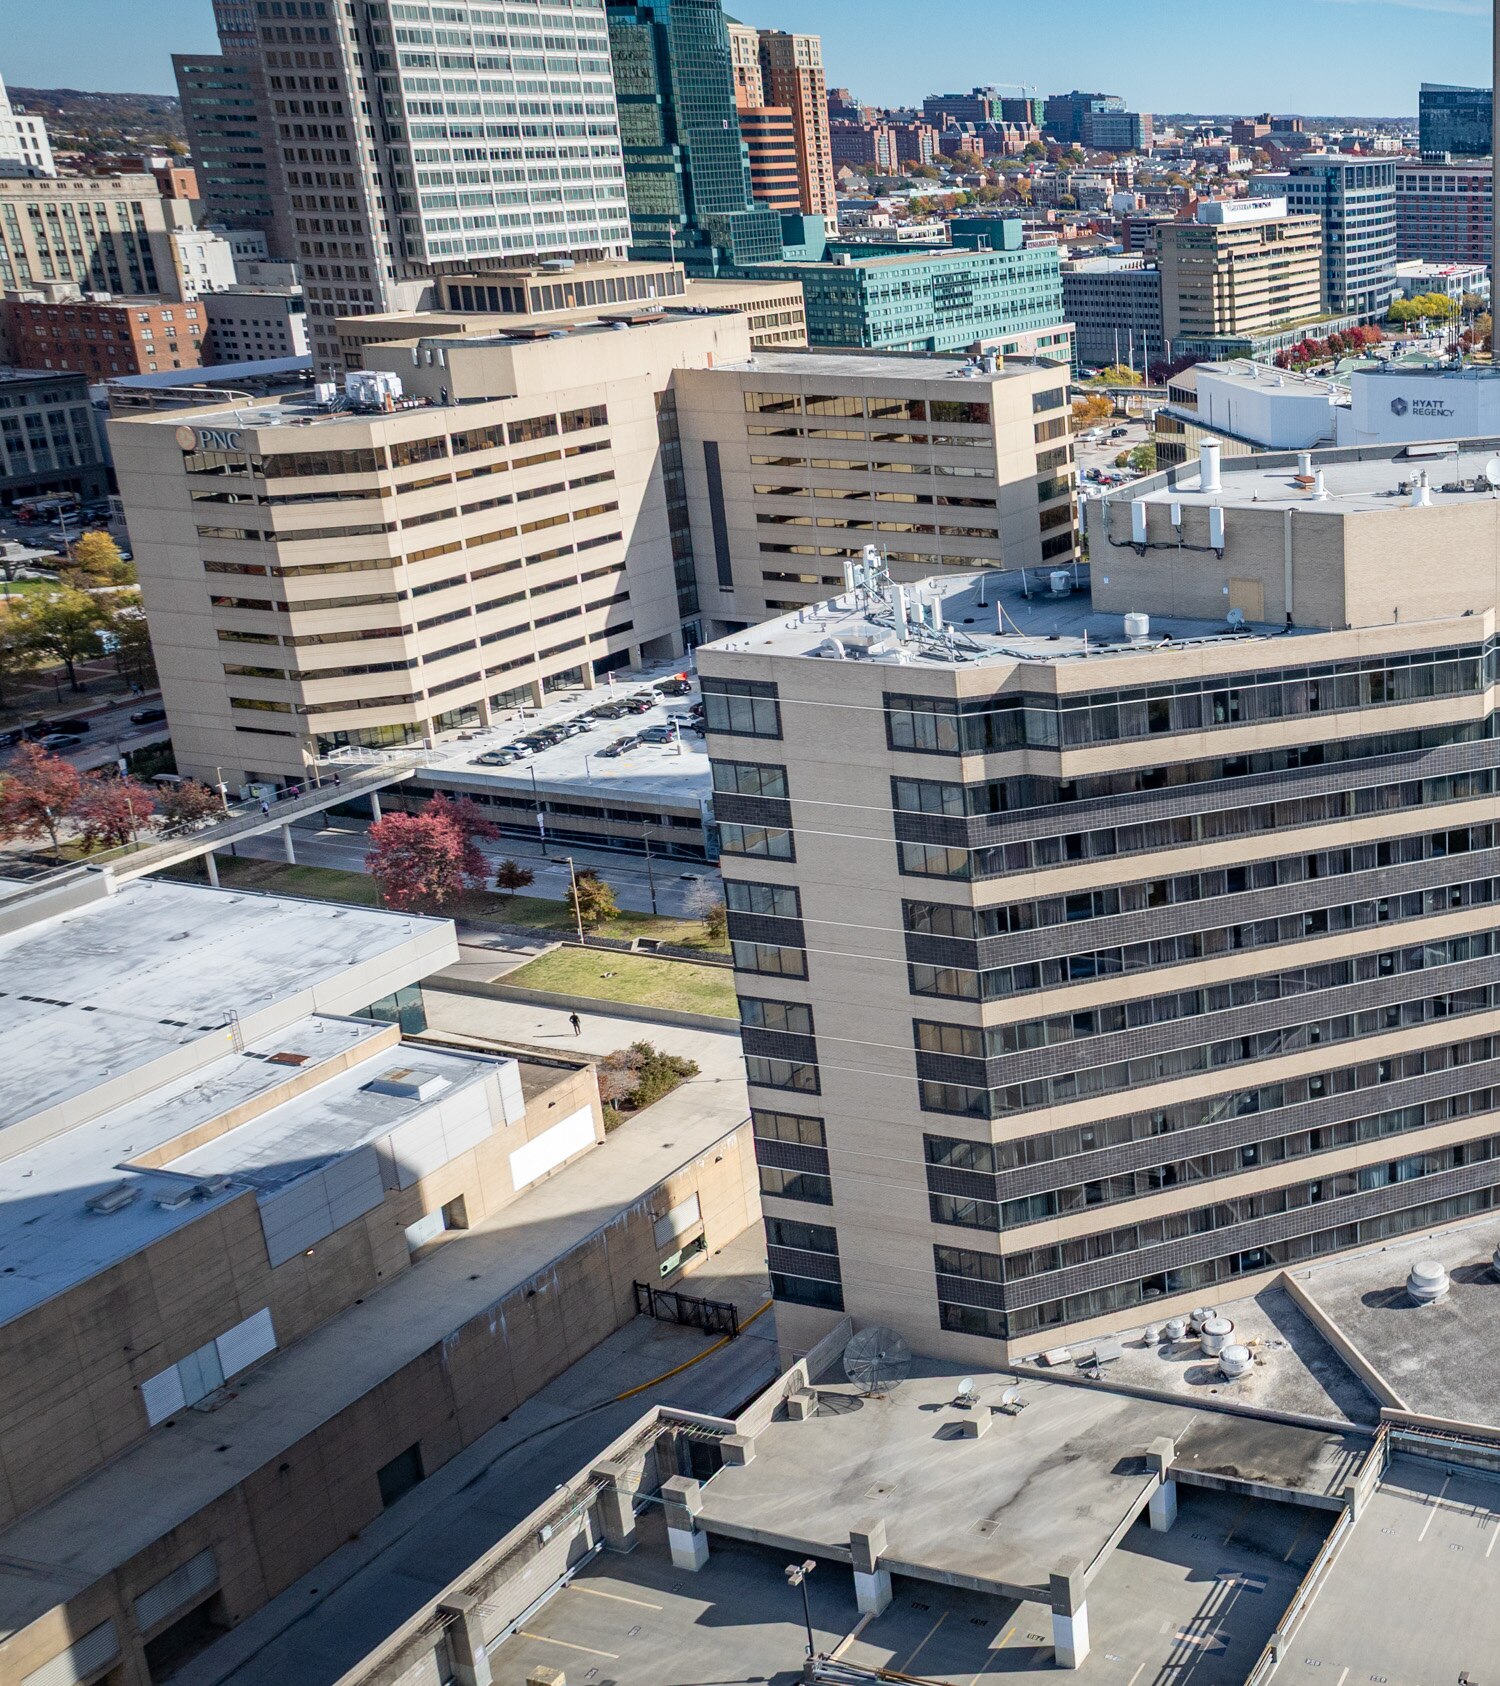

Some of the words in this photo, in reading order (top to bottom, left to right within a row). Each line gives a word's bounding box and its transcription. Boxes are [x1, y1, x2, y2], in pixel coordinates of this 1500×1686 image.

[1412, 400, 1444, 408] HYATT
[1412, 408, 1455, 417] REGENCY
[199, 429, 242, 451] PNC
